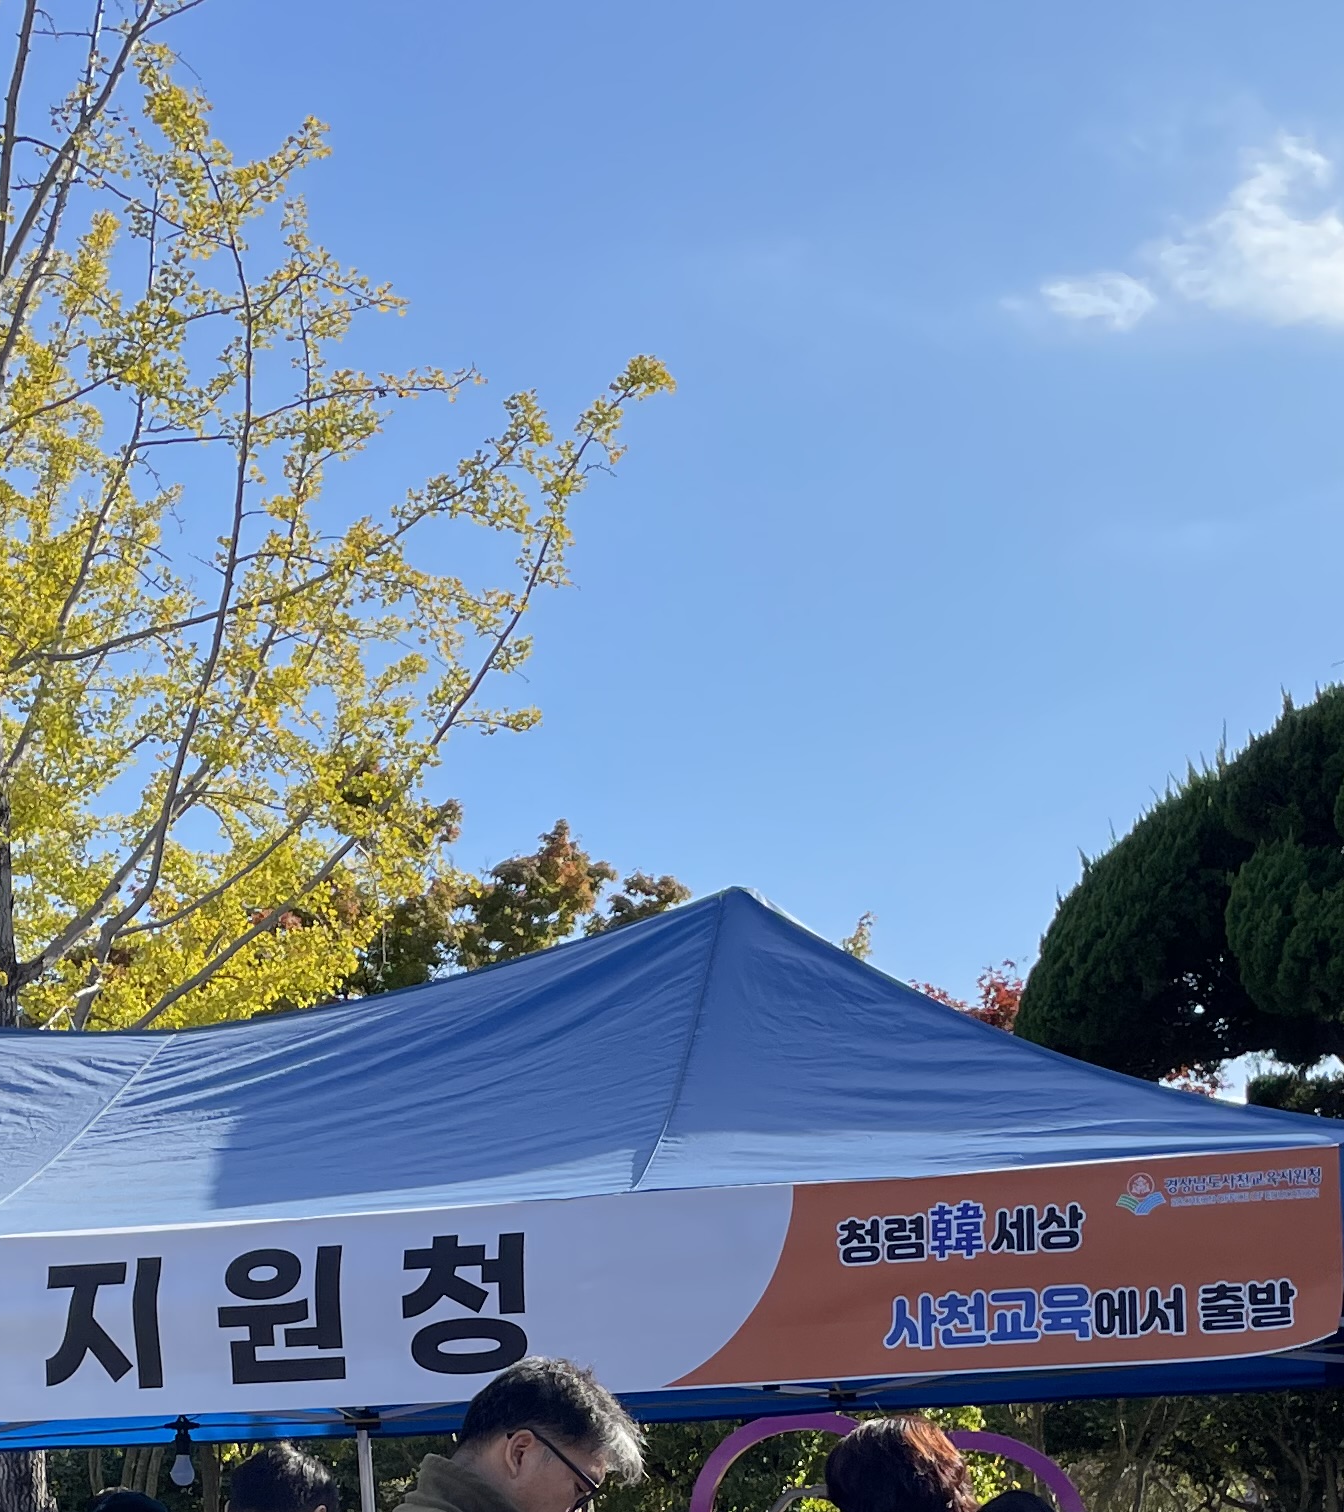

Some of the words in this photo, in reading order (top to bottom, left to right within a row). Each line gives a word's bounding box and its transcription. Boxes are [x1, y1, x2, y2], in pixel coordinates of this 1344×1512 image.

[1165, 1167, 1322, 1194] 경상남도사천교육지원청
[837, 1202, 985, 1267] 청렴韓
[990, 1201, 1085, 1254] 세상
[884, 1284, 1187, 1351] 사천교육에서
[1197, 1278, 1298, 1333] 출발
